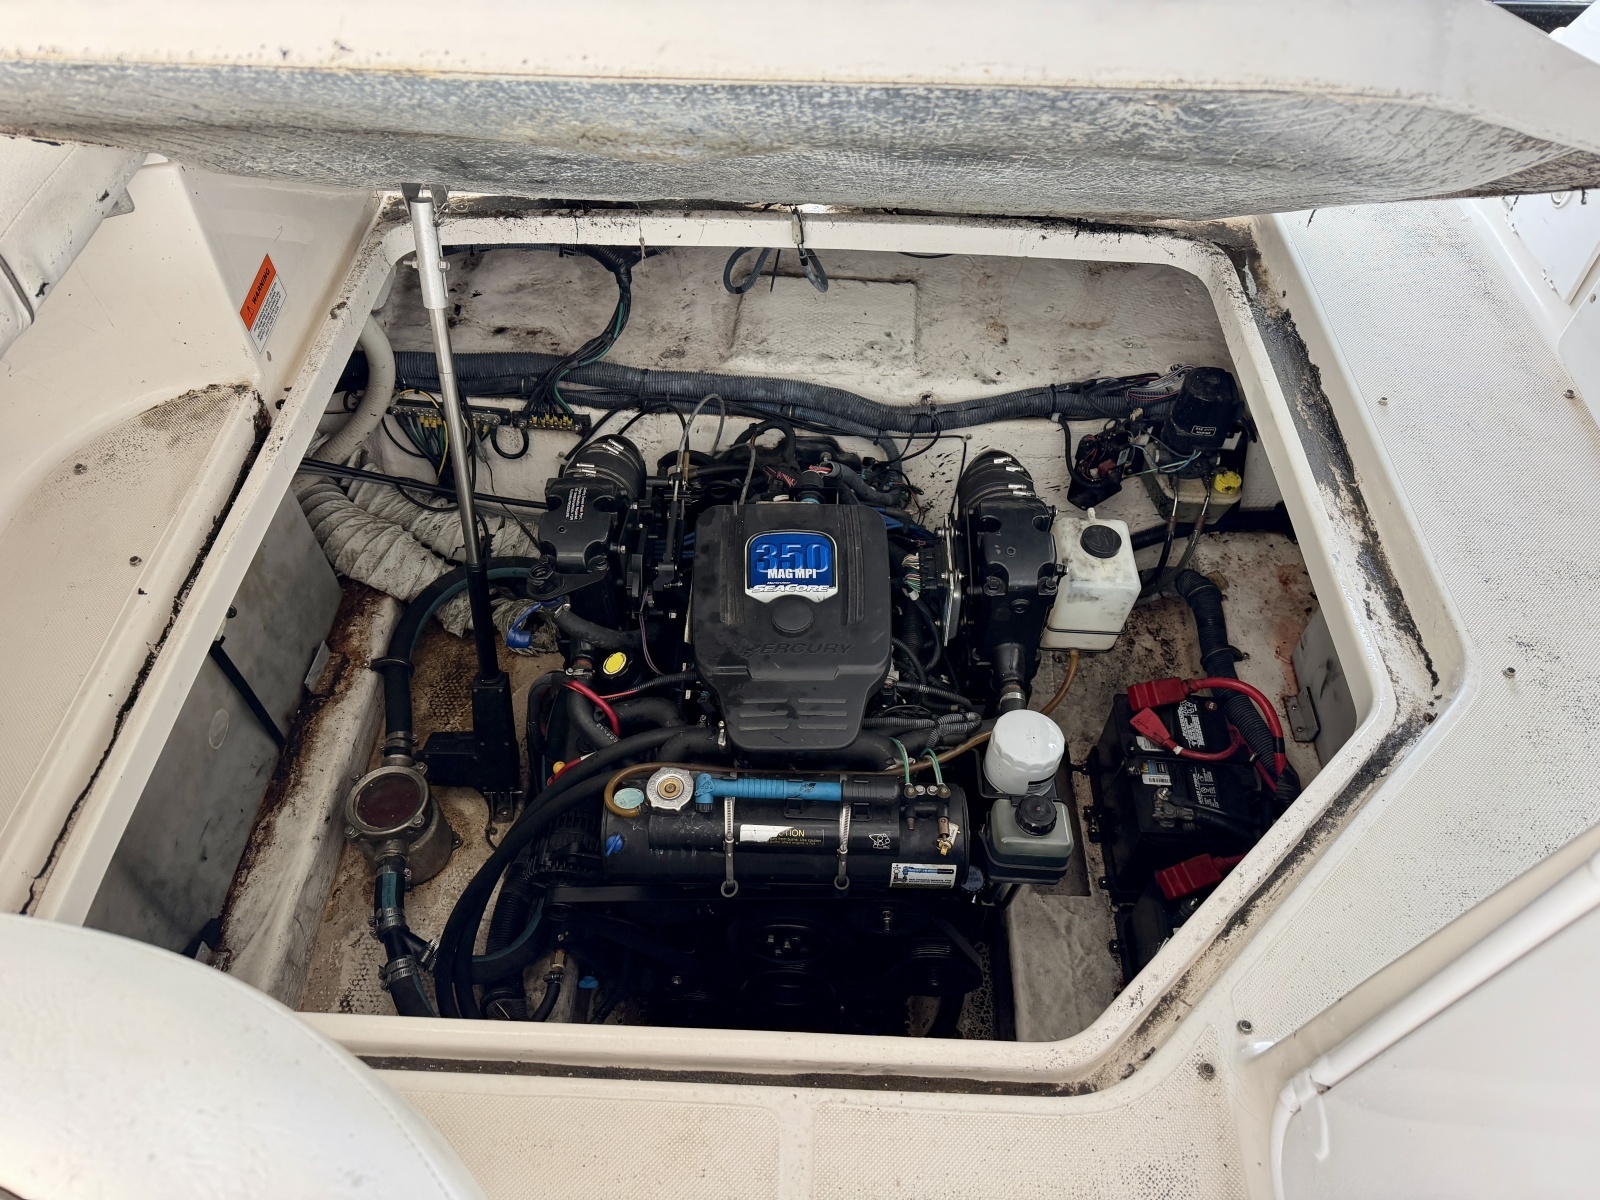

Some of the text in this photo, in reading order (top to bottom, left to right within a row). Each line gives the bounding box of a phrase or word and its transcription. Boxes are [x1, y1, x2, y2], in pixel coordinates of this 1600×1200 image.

[252, 268, 270, 304] WARNING
[755, 543, 829, 572] 350
[767, 568, 817, 579] MAG MPI
[741, 643, 854, 657] MERCURY
